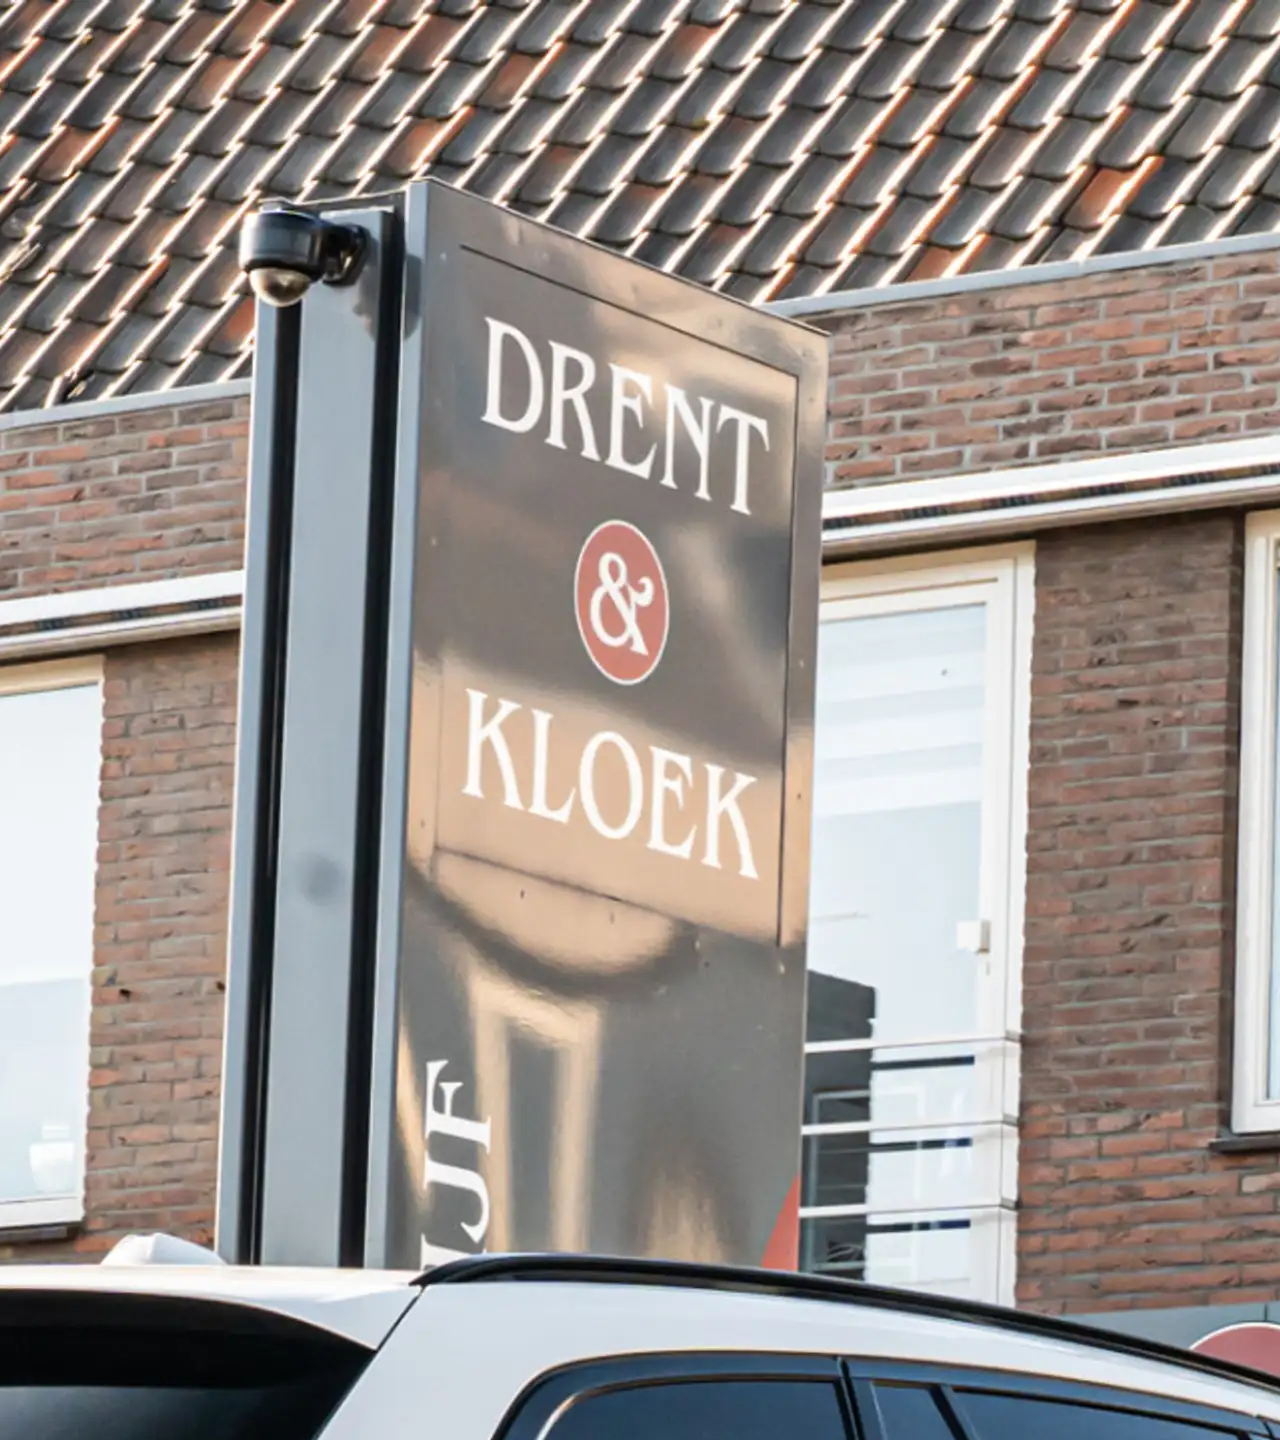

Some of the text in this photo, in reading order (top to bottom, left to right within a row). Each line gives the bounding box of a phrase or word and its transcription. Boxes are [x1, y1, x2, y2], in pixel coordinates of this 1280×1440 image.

[481, 316, 770, 516] DRENT
[590, 551, 654, 656] &
[461, 688, 760, 880] KLOEK
